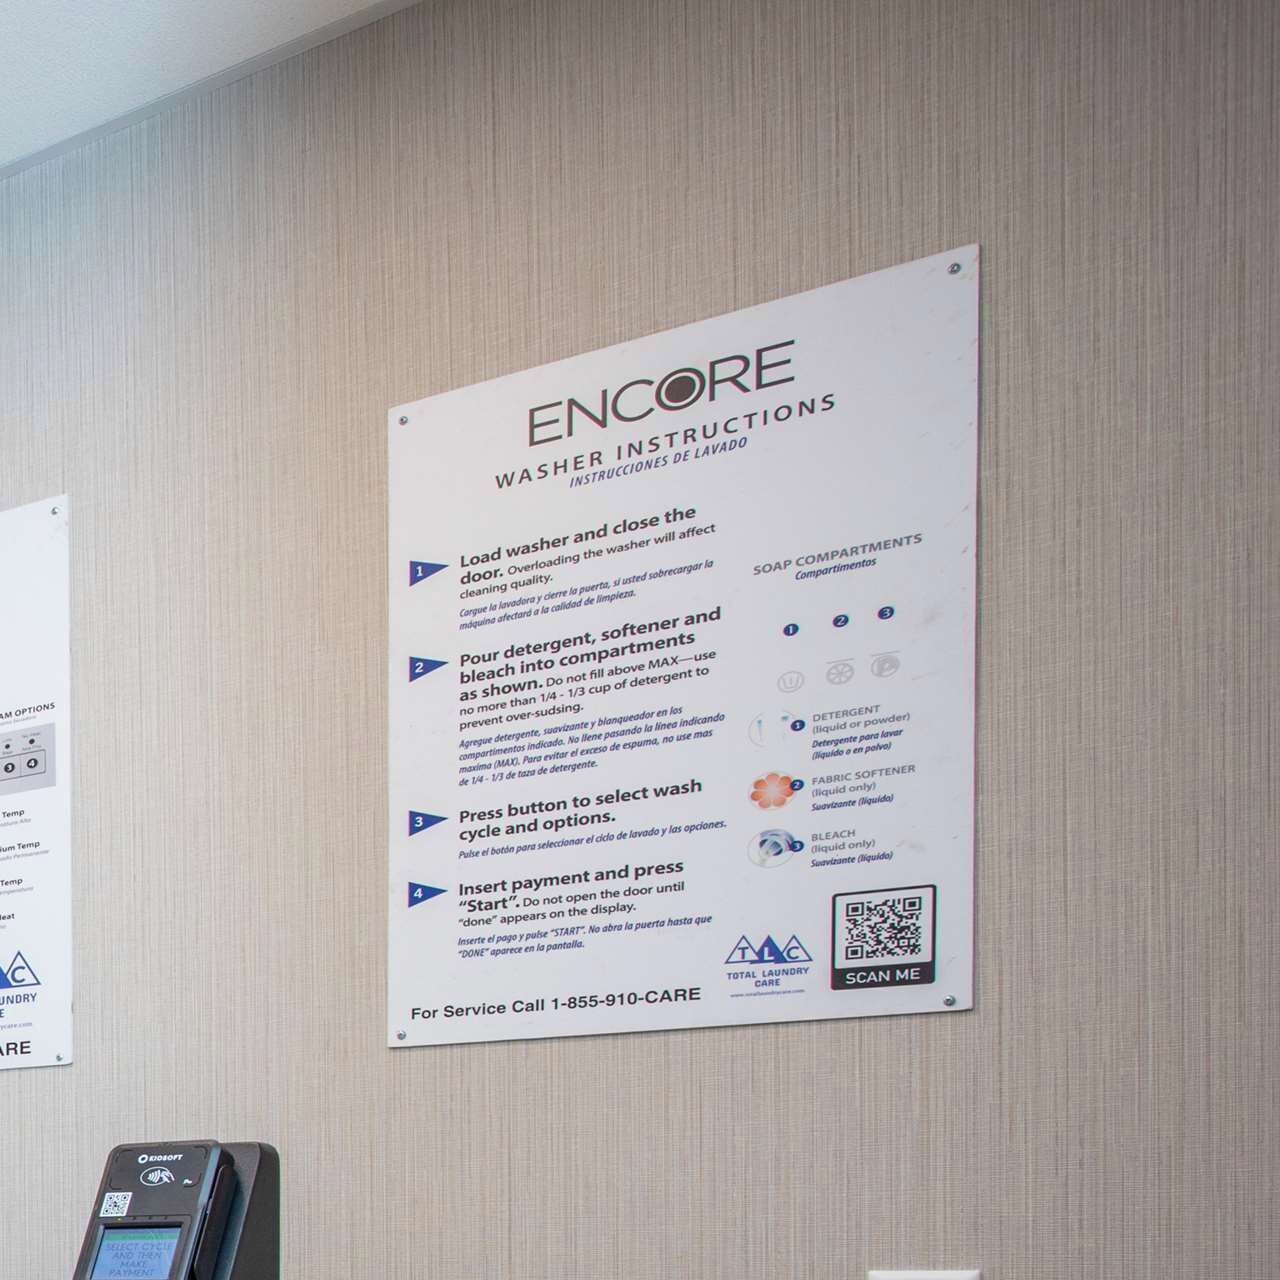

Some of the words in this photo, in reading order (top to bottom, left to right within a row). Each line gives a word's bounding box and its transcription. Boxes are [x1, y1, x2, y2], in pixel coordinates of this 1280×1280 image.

[529, 338, 795, 446] ENCORE
[495, 450, 602, 488] WASHER
[617, 393, 834, 460] INSTRUCTIONS
[570, 454, 668, 488] INSTRUCCIONES
[673, 449, 690, 463] DE
[694, 436, 747, 458] LAVADO
[461, 546, 501, 567] Load
[506, 535, 569, 557] washer
[573, 523, 607, 543] and
[613, 515, 659, 534] close
[664, 507, 696, 523] the
[754, 559, 792, 575] SOAP
[795, 532, 922, 566] COMPARTMENTS
[460, 650, 499, 666] Pour
[504, 632, 596, 658] detergent,
[601, 617, 679, 641] softener
[684, 605, 720, 625] and
[460, 663, 515, 683] bleach
[520, 658, 555, 673] into
[559, 632, 695, 666] compartments
[14, 701, 55, 716] OPTIONS
[813, 704, 880, 722] DETERGENT
[812, 772, 851, 784] FABRIC
[855, 764, 915, 779] SOFTENER
[2, 809, 24, 817] Temp
[460, 808, 503, 823] Press
[508, 799, 567, 816] button
[572, 796, 591, 808] to
[595, 786, 648, 805] select
[653, 778, 702, 797] wash
[459, 824, 501, 842] cycle
[505, 817, 538, 834] and
[543, 812, 615, 831] options.
[811, 829, 855, 841] BLEACH
[17, 841, 40, 849] Temp
[0, 878, 23, 886] Temp
[459, 879, 507, 895] Insert
[512, 870, 590, 893] payment
[594, 864, 629, 881] and
[634, 861, 683, 880] press
[738, 945, 799, 959] TLC
[727, 970, 757, 979] TOTAL
[762, 966, 809, 977] LAUNDRY
[754, 977, 780, 987] CARE
[846, 969, 890, 984] SCAN
[896, 967, 920, 980] ME
[411, 1007, 438, 1019] For
[444, 1002, 506, 1017] Service
[512, 998, 544, 1012] Call
[552, 986, 701, 1009] 1-855-910-CARE
